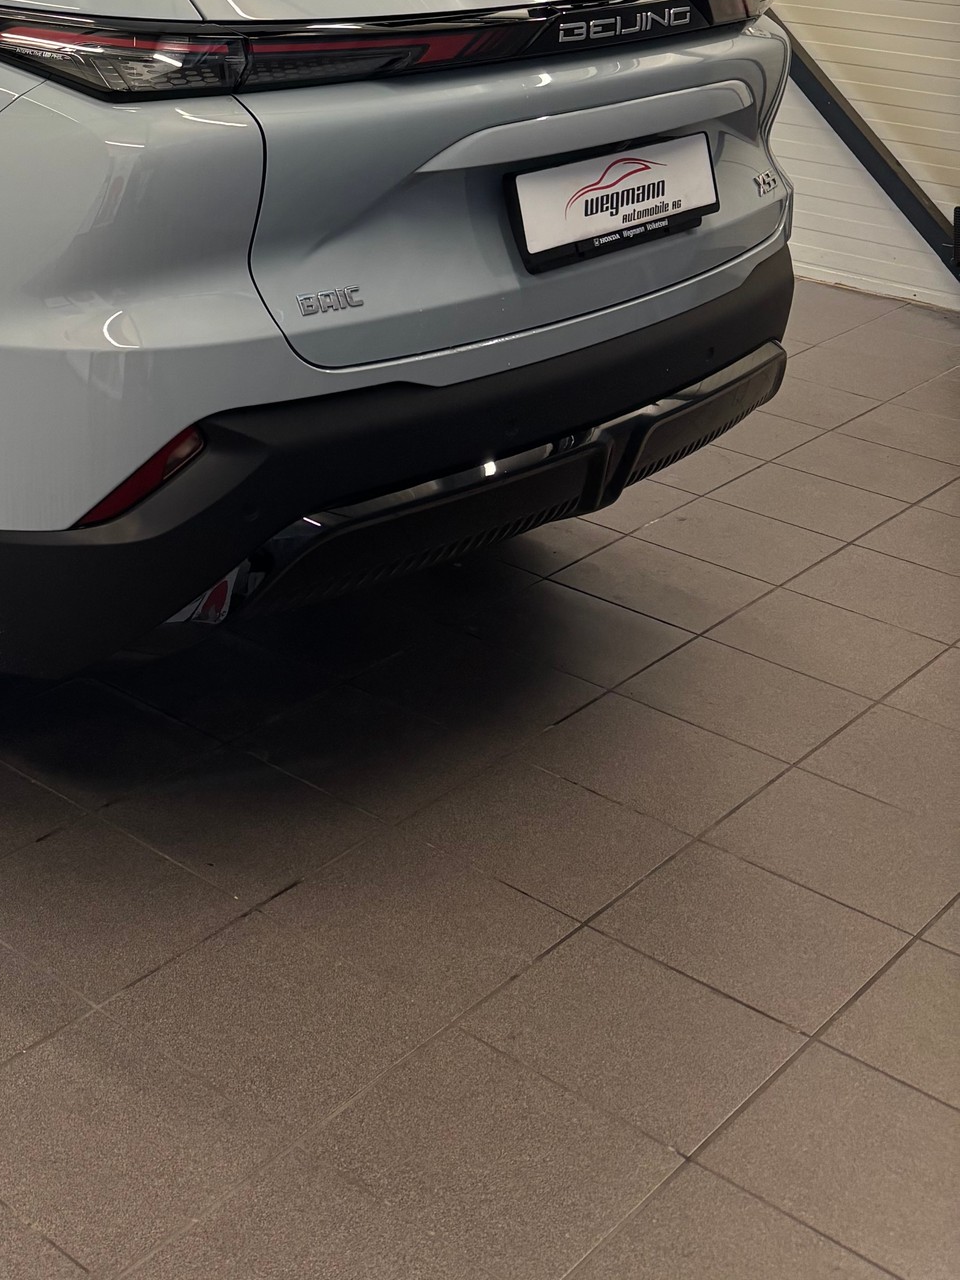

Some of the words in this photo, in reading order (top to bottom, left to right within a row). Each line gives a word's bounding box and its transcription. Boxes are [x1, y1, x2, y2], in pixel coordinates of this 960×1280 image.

[558, 6, 691, 43] BEIJING
[584, 180, 665, 217] wegmann
[672, 199, 682, 210] AG
[600, 233, 621, 244] HONDA
[622, 226, 645, 238] Wegmann
[296, 285, 364, 317] BAIC
